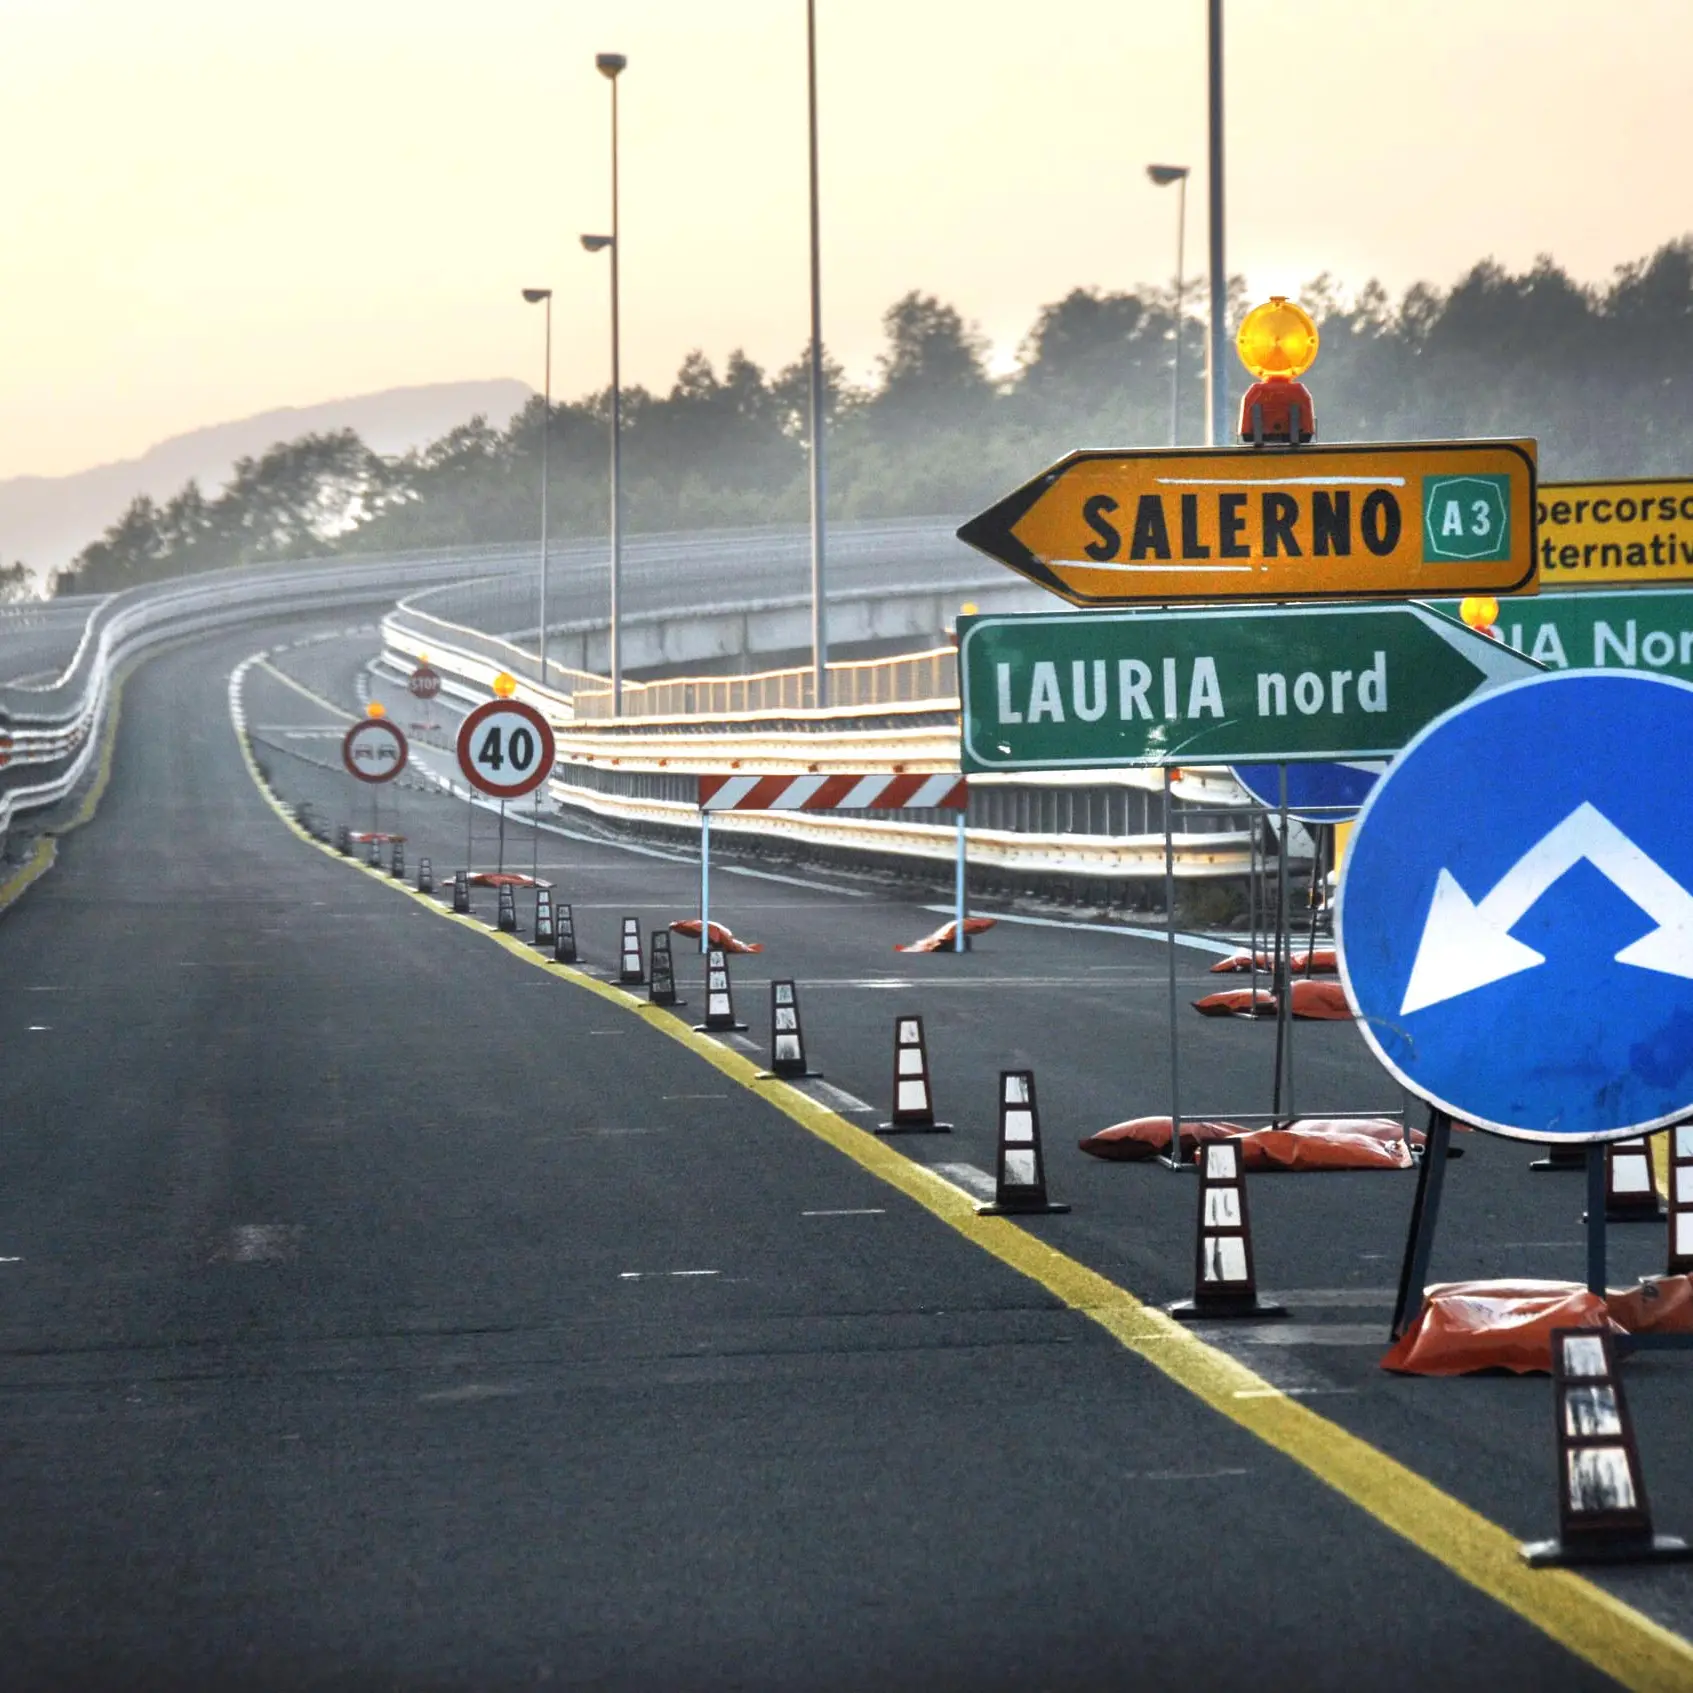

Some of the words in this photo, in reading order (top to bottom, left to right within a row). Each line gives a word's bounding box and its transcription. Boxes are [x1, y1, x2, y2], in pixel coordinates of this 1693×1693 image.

[1082, 488, 1402, 561] SALERNO
[1489, 622, 1569, 669] IA
[411, 676, 438, 692] STOP
[996, 656, 1225, 724] LAURIA
[1257, 650, 1387, 717] nord
[478, 727, 534, 771] 40
